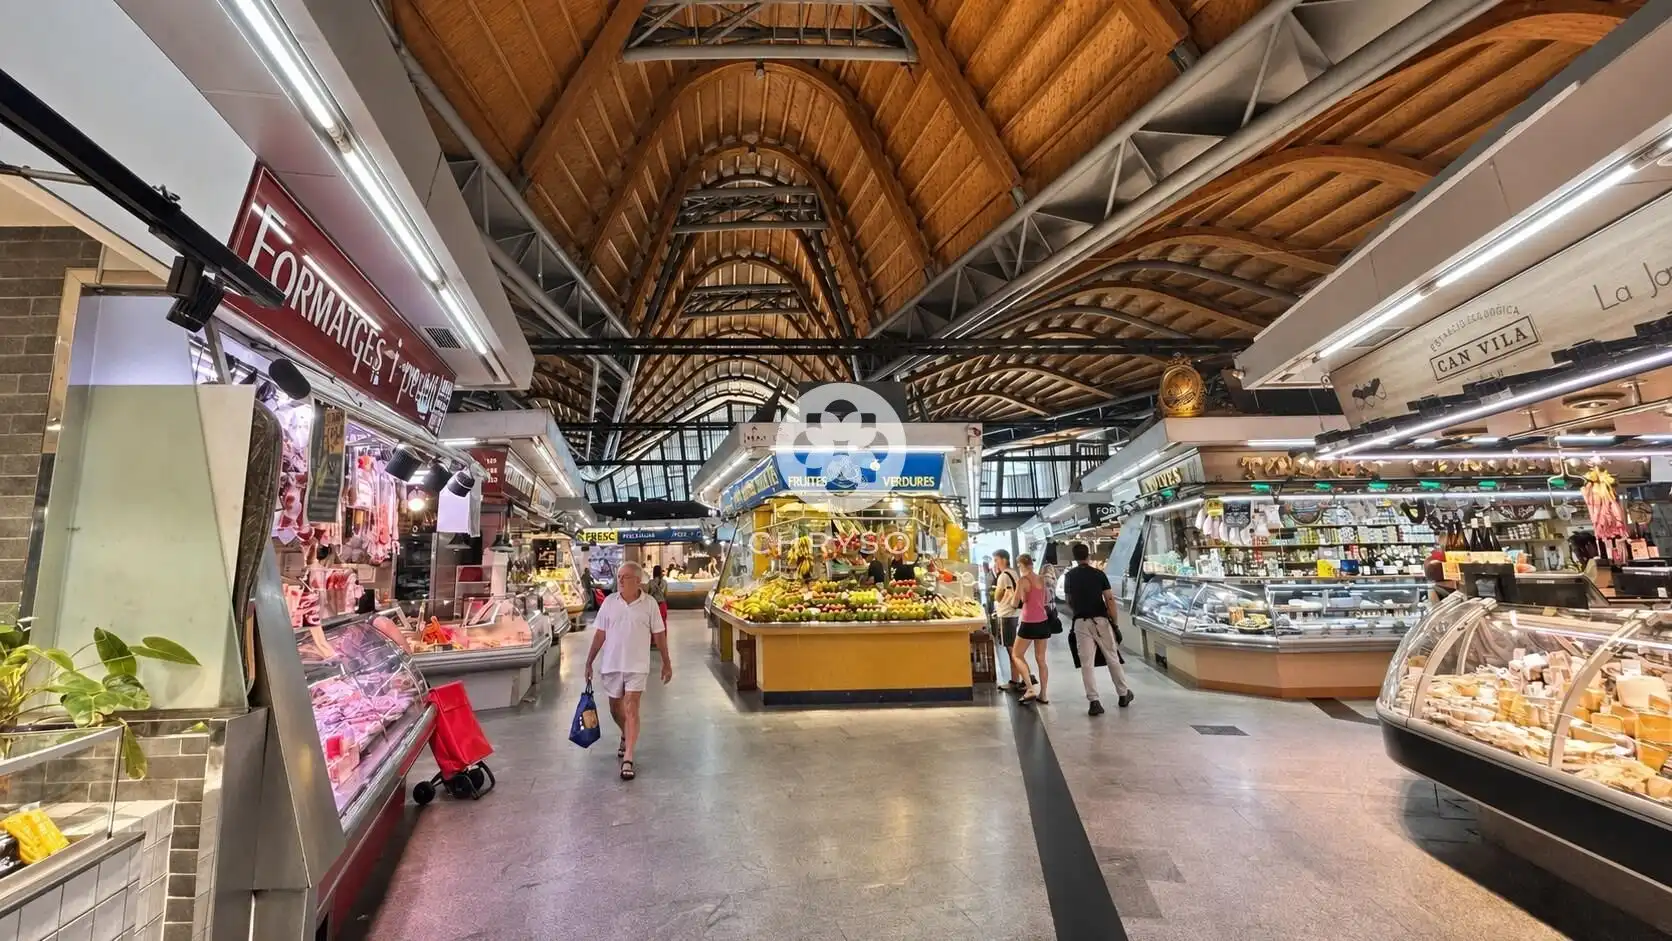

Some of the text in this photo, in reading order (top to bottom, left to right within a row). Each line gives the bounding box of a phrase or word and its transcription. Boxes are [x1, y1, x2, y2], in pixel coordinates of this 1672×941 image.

[1593, 261, 1672, 311] La Ja
[1437, 327, 1529, 373] CAN VILA
[788, 475, 827, 487] FRUITES
[882, 475, 935, 487] VERDURES
